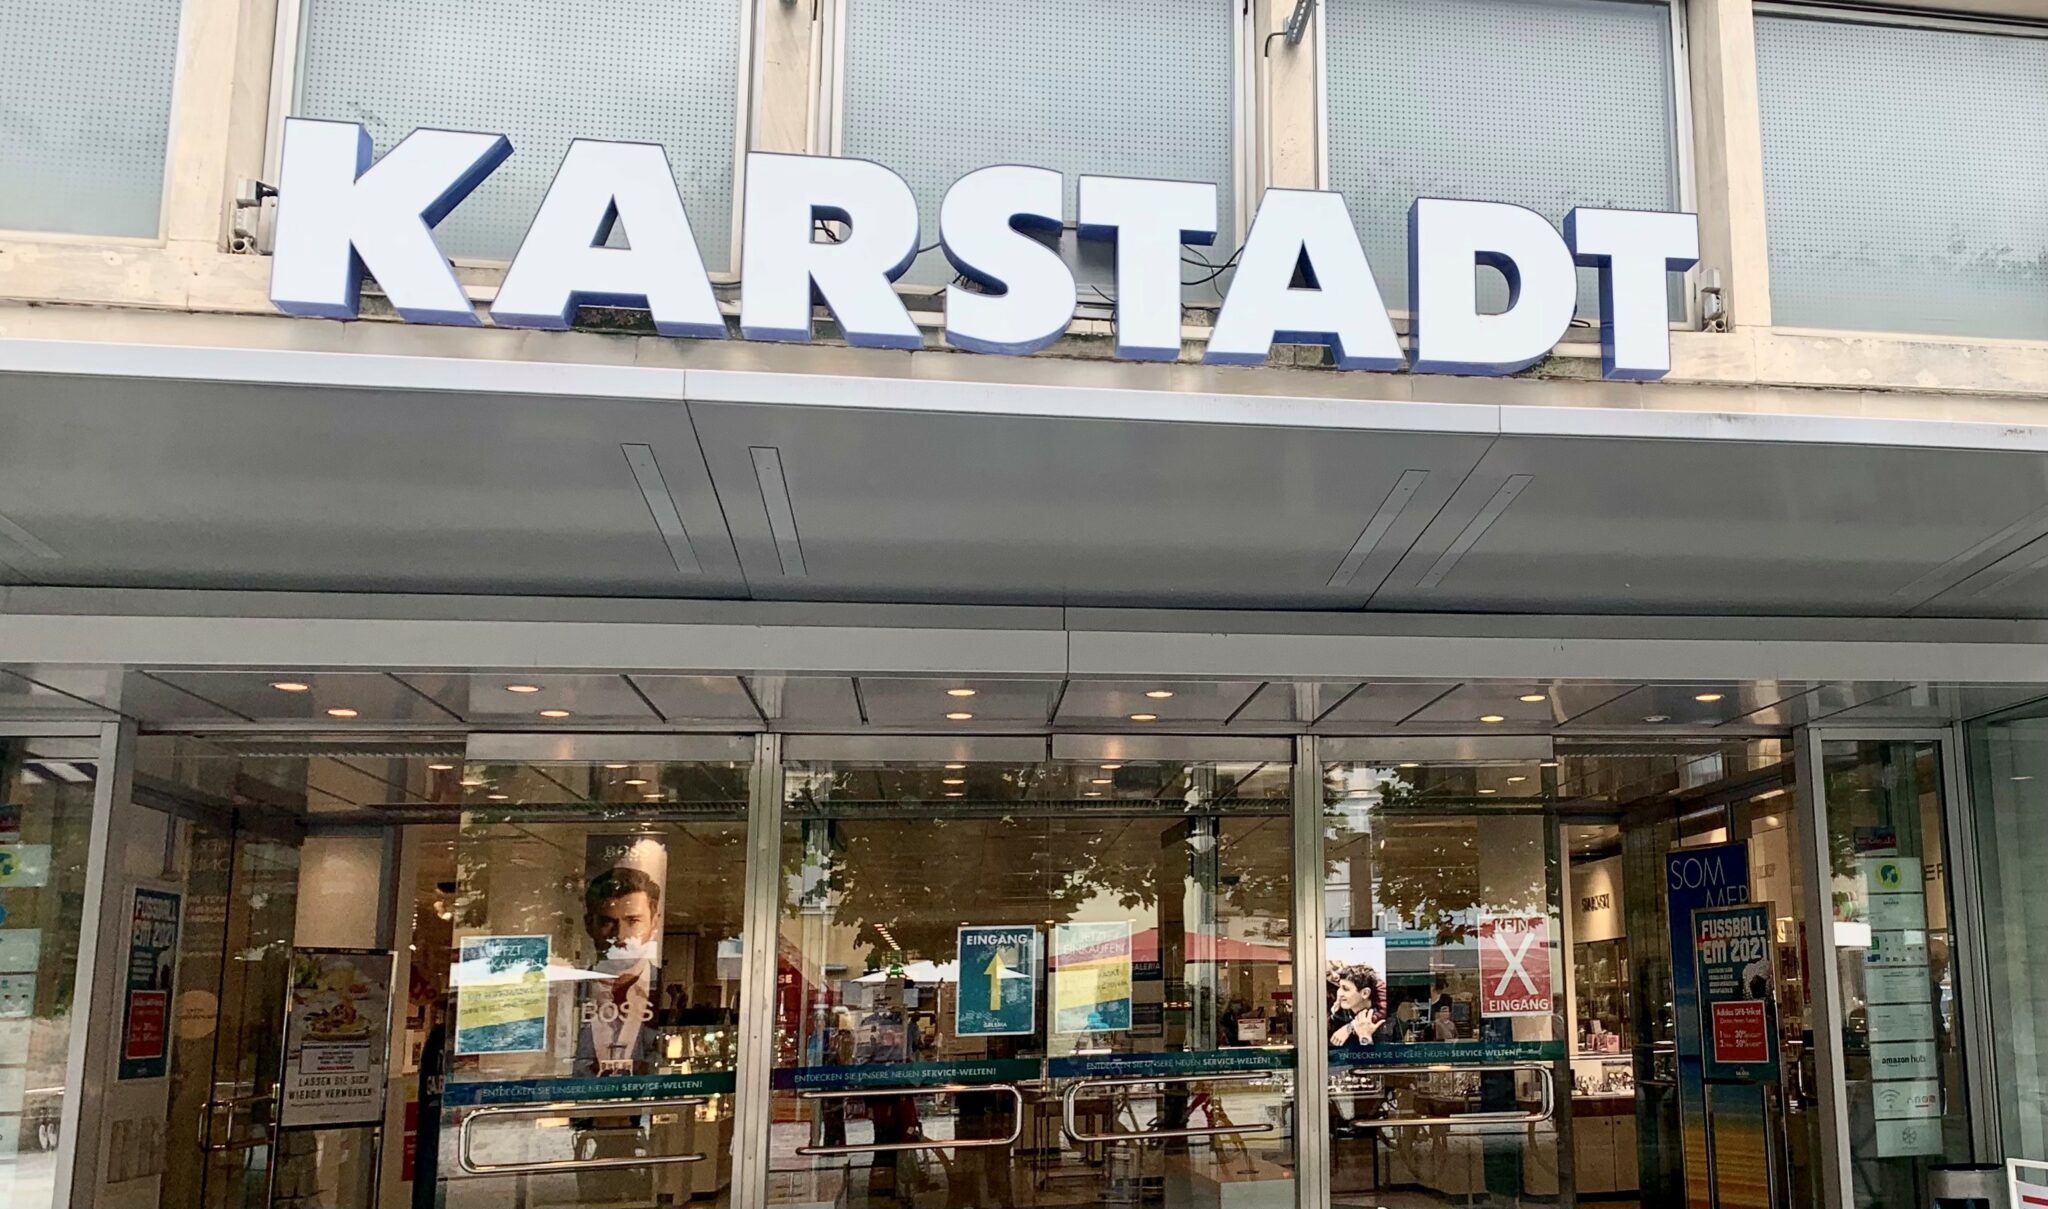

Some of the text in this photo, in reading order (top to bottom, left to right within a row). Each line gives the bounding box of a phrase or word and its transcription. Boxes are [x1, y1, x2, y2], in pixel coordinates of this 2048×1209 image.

[270, 116, 1700, 380] KARSTADT
[1671, 856, 1726, 890] SOM
[1494, 918, 1529, 934] KEIN
[1702, 915, 1766, 939] FUSSBALL
[966, 934, 1028, 946] EINGANG
[1730, 937, 1768, 962] 2021
[581, 1001, 655, 1023] BOSS
[1489, 999, 1549, 1012] EINGANG
[1175, 1057, 1200, 1067] NEUEN
[1202, 1056, 1271, 1066] SERVICE-WELTEN!
[1395, 1050, 1423, 1059] UNSERE
[1424, 1049, 1450, 1058] NEUEN
[1882, 1054, 1926, 1065] amazon hub
[298, 1077, 331, 1087] LASSEN
[351, 1075, 370, 1085] SICH
[794, 1067, 997, 1082] ENTDECKEN SIE UNSERE NEUEN SERVICE-WELTEN!
[288, 1090, 321, 1100] WIEDER
[552, 1085, 586, 1095] UNSERE
[589, 1083, 619, 1093] NEUEN
[621, 1080, 703, 1092] SERVICE-WELTEN!
